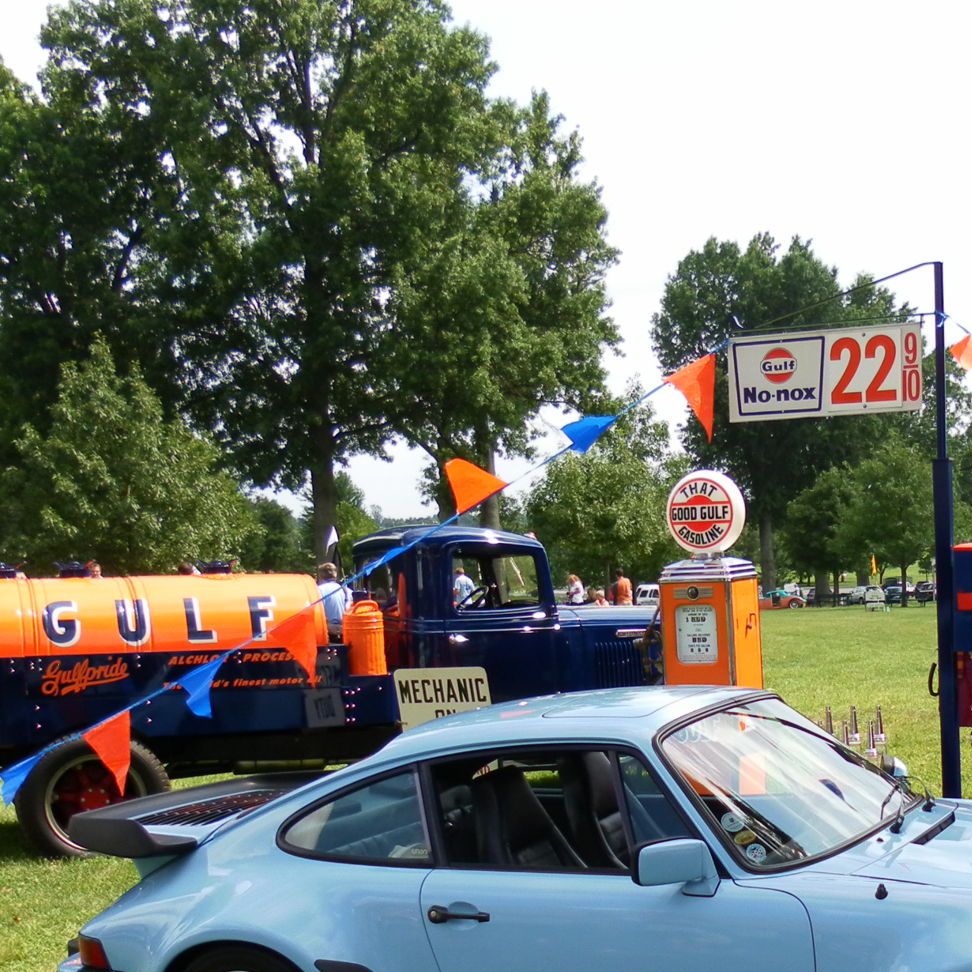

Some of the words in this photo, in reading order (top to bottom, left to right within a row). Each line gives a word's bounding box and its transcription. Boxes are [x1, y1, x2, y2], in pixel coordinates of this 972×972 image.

[904, 332, 918, 364] 9
[762, 361, 796, 372] Gulf
[830, 334, 897, 404] 22
[902, 369, 920, 401] 10
[680, 482, 718, 499] THAT
[672, 506, 697, 521] GOOD
[700, 505, 729, 520] GULF
[678, 523, 724, 545] GASOLINE
[42, 595, 277, 648] GULF
[41, 655, 130, 697] Gulfpride
[233, 677, 267, 688] finest
[268, 676, 304, 686] motor
[398, 678, 488, 704] MECHANIC
